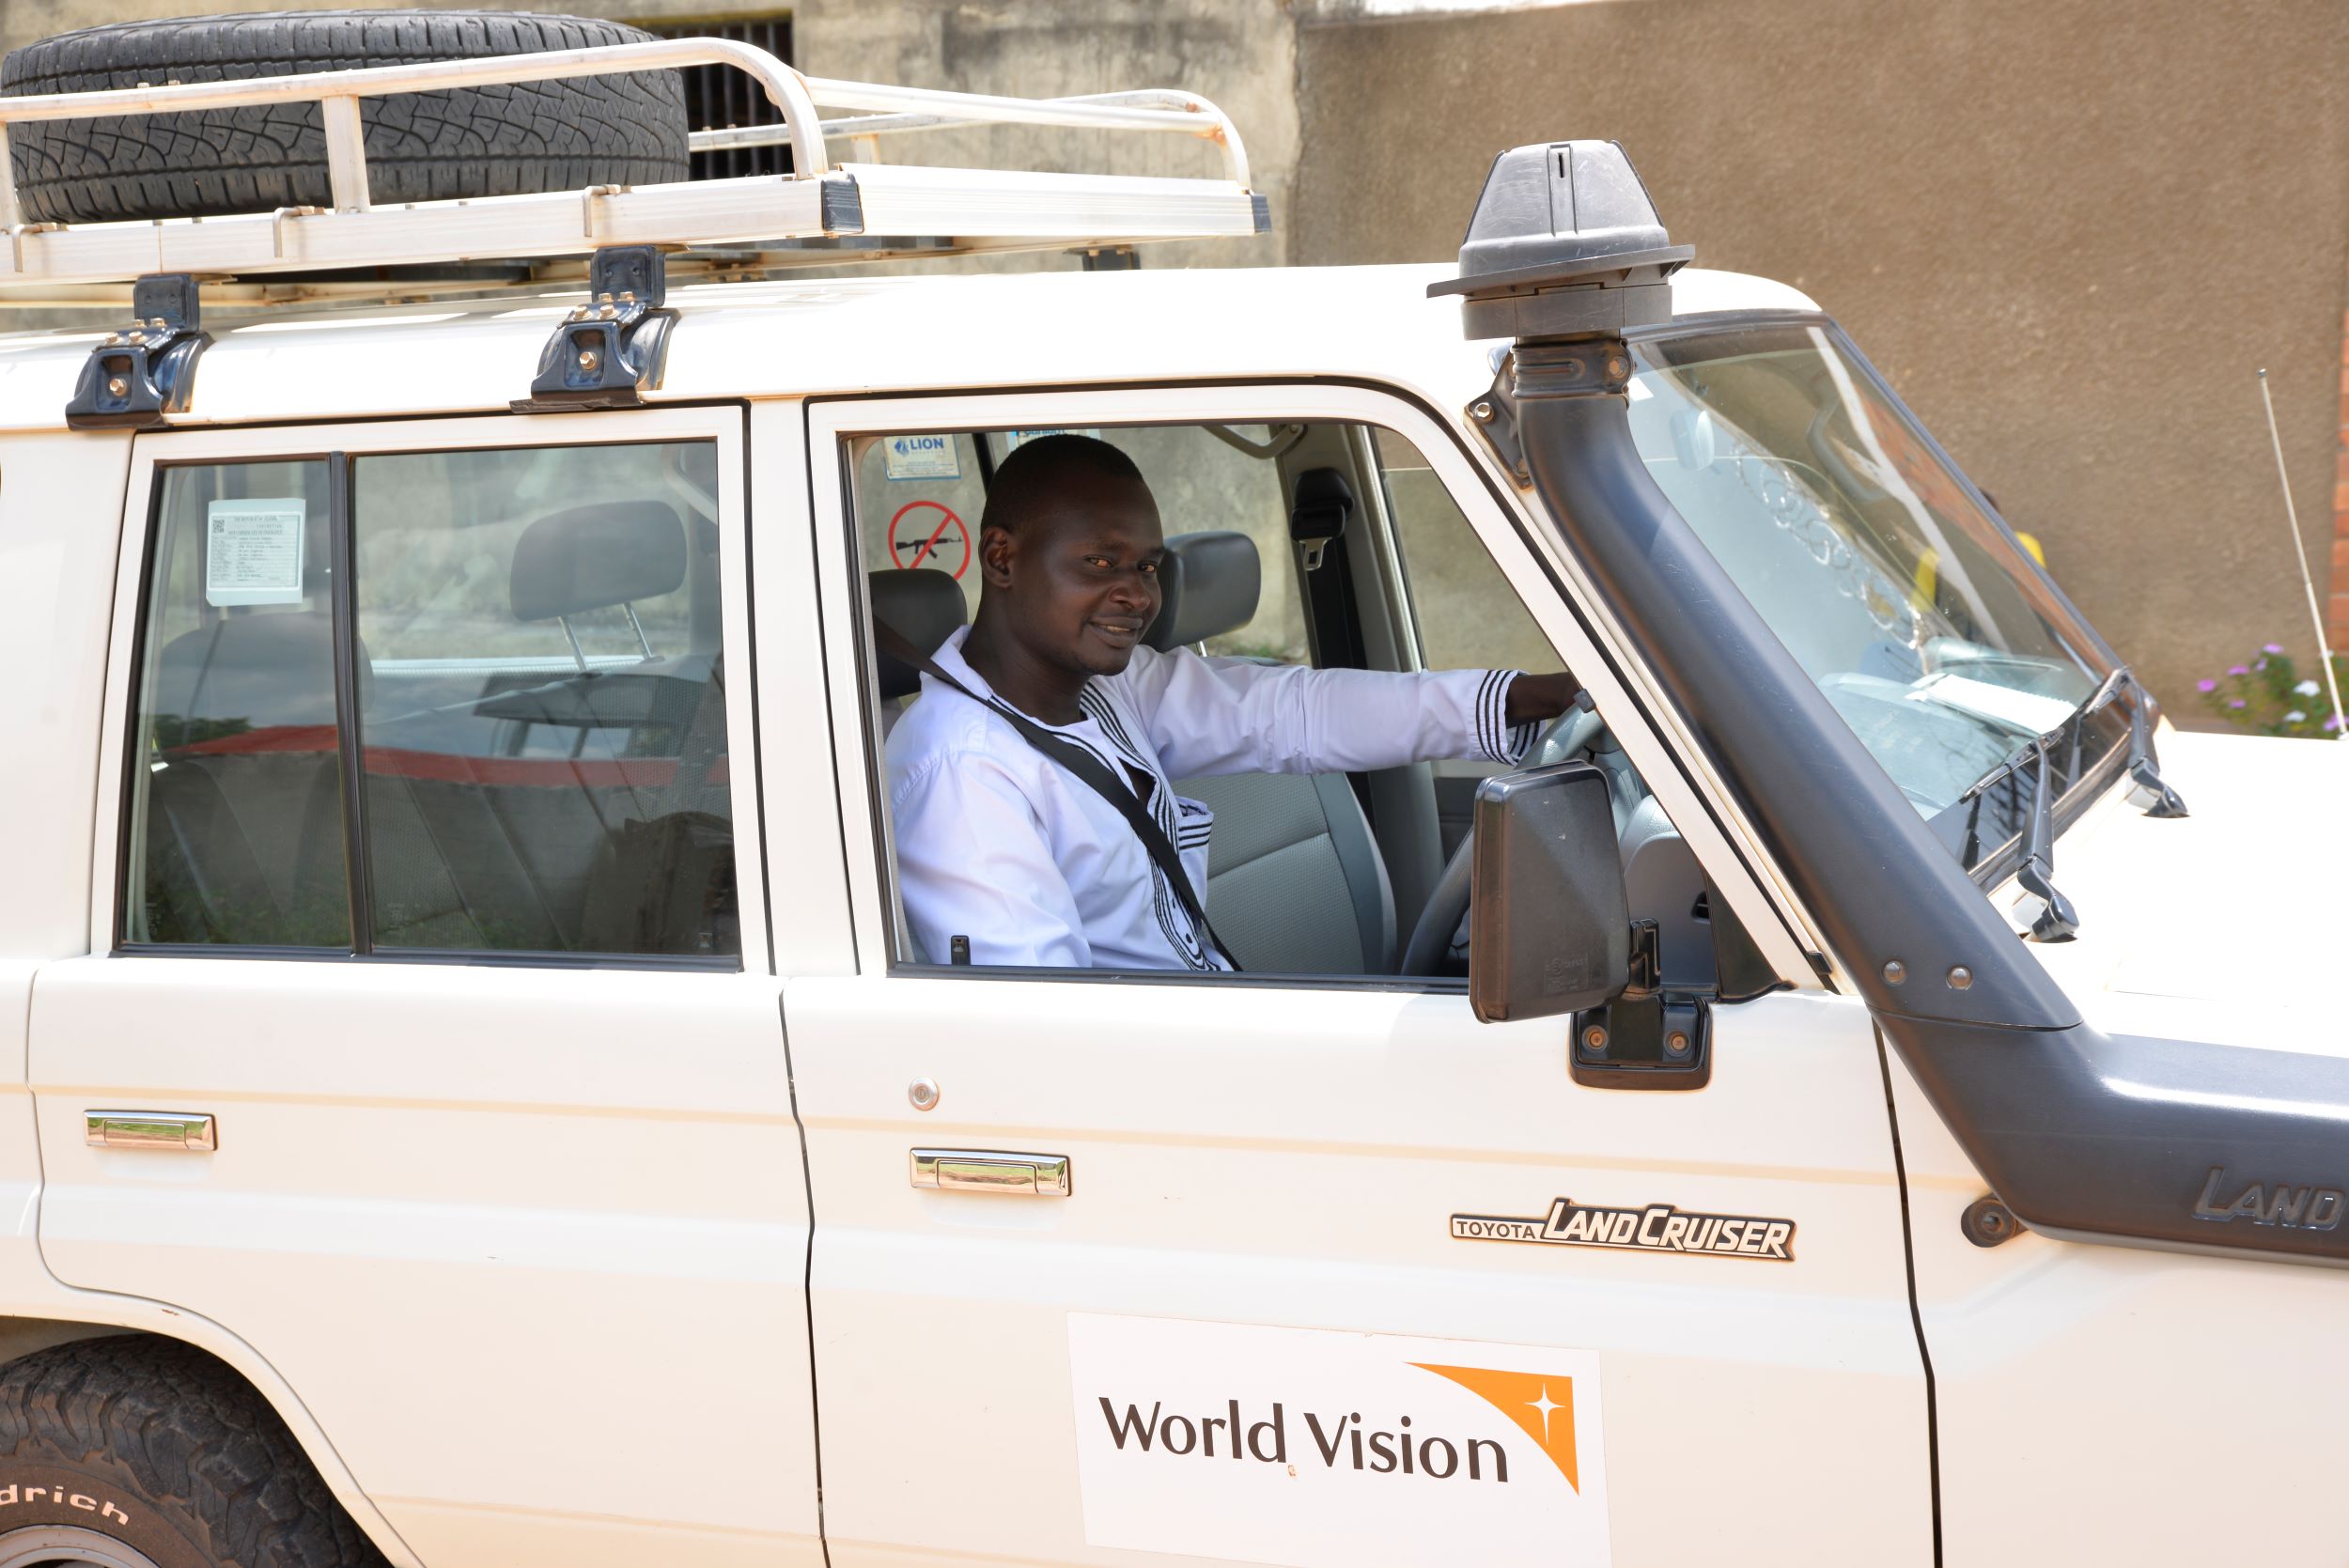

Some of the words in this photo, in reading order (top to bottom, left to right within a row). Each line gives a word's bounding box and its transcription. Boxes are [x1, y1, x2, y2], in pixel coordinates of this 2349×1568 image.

[910, 438, 944, 450] LION
[2193, 1165, 2347, 1231] LAND
[1456, 1220, 1536, 1240] TOYOTA
[1098, 1396, 1286, 1464] World
[1303, 1412, 1508, 1483] Vision
